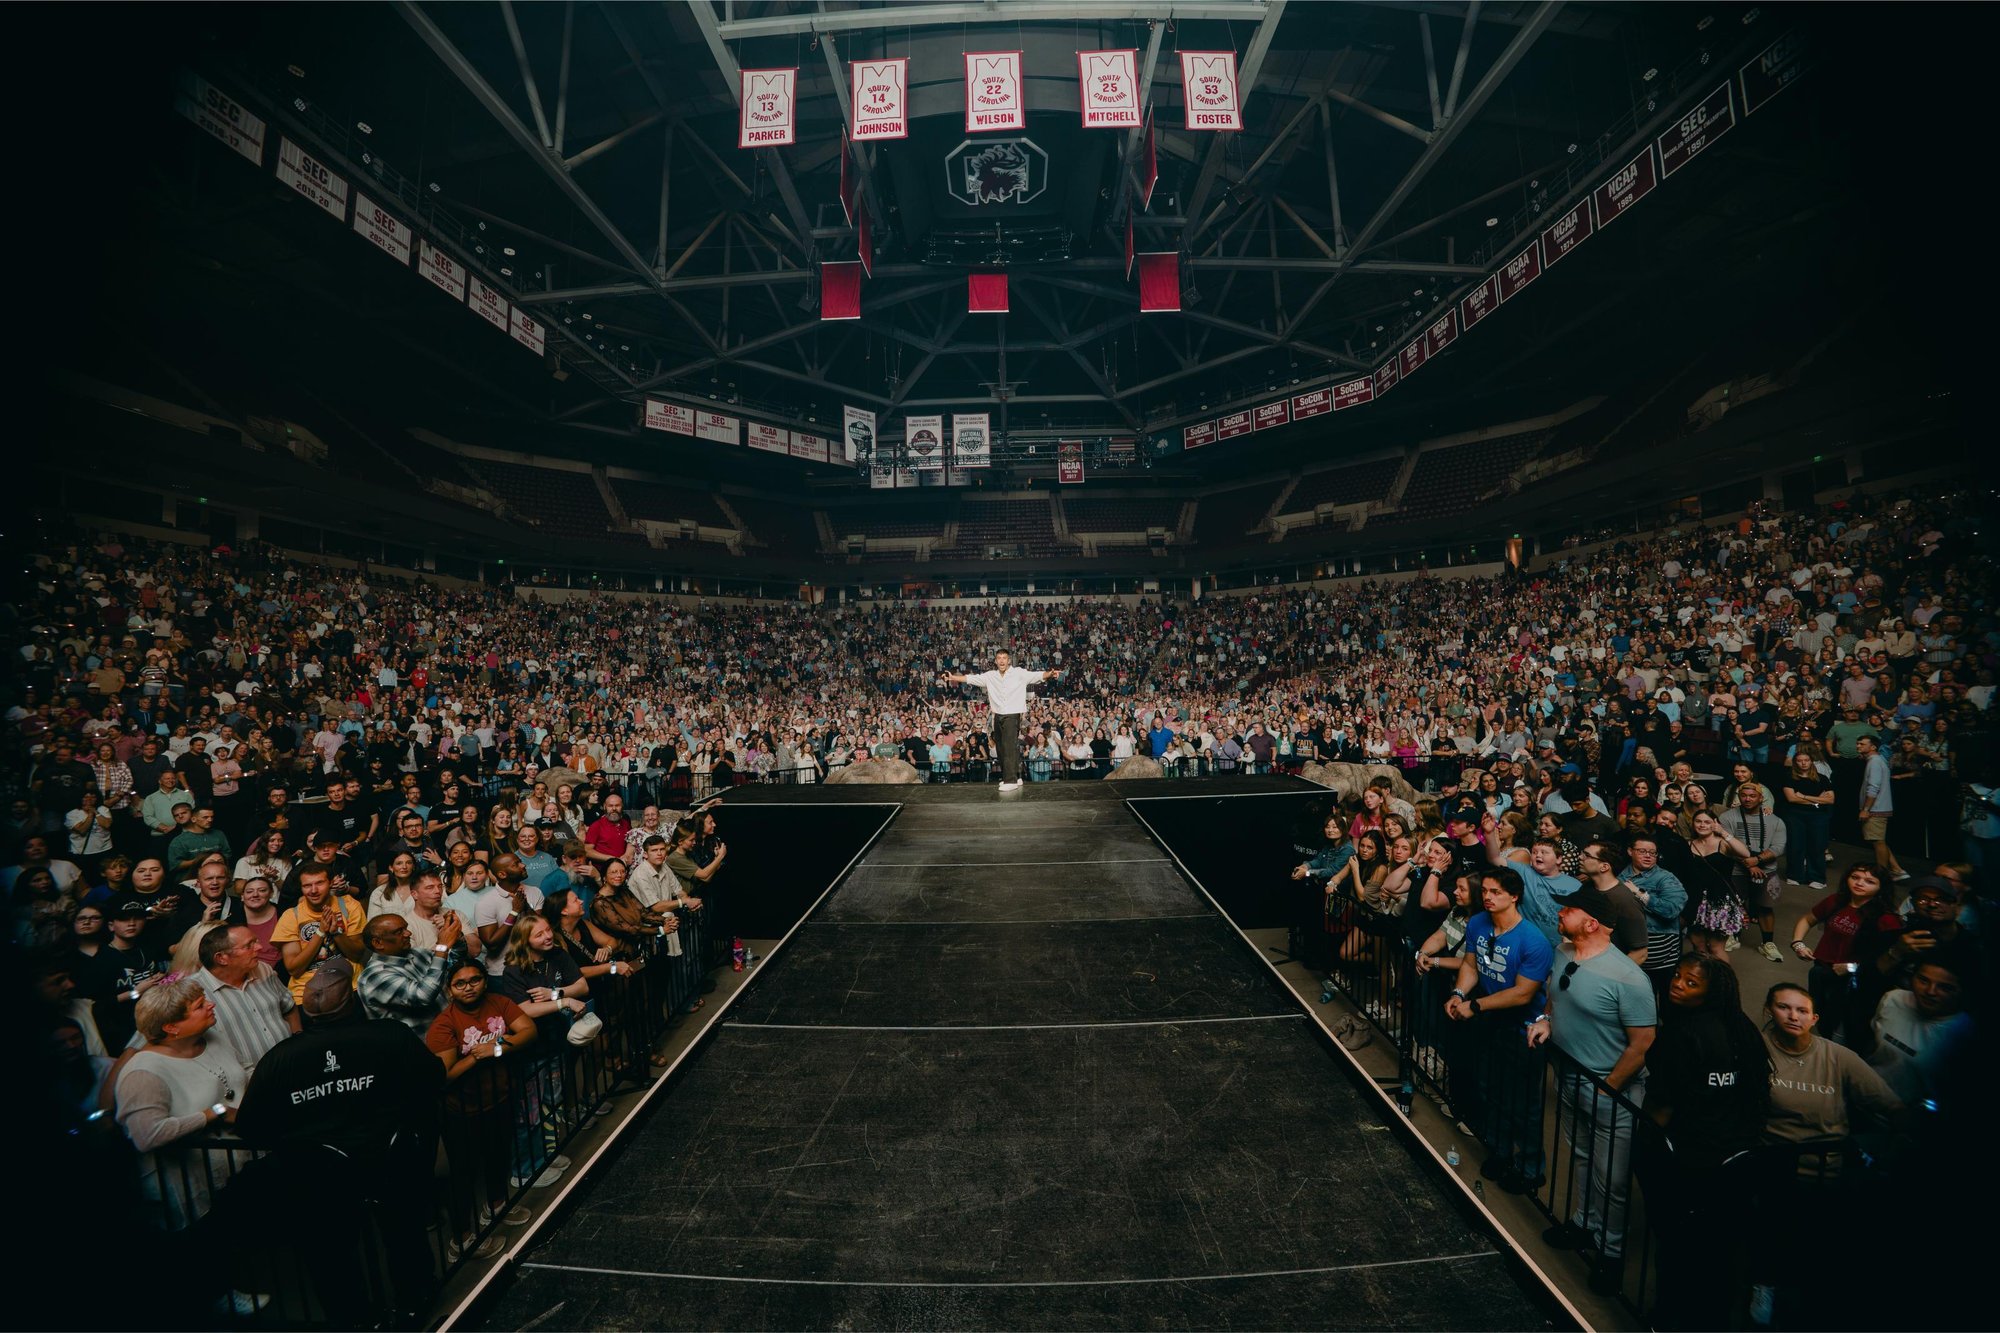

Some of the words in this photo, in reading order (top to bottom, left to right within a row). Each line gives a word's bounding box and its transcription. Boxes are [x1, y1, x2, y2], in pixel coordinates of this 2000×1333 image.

[982, 77, 1005, 85] SOUTH
[1097, 75, 1121, 84] SOUTH
[1199, 76, 1223, 85] SOUTH
[867, 85, 891, 94] SOUTH
[986, 84, 1002, 95] 22
[1102, 82, 1118, 93] 25
[1204, 85, 1219, 95] 53
[757, 93, 780, 102] SOUTH
[872, 94, 886, 104] 14
[977, 93, 1011, 105] CAROLINA
[1093, 91, 1128, 103] CAROLINA
[1195, 93, 1229, 106] CAROLINA
[207, 88, 240, 122] SEC
[762, 102, 774, 112] 13
[861, 103, 896, 115] CAROLINA
[751, 110, 784, 122] CAROLINA
[975, 113, 1015, 126] WILSON
[1088, 110, 1137, 122] MITCHELL
[1196, 114, 1233, 125] FOSTER
[1680, 106, 1707, 138] SEC
[748, 129, 786, 142] PARKER
[856, 122, 902, 136] JOHNSON
[1686, 134, 1706, 156] 1997
[302, 156, 328, 185] SEC
[1607, 163, 1638, 198] NCAA
[296, 180, 329, 208] 2019-20
[1616, 193, 1634, 210] 1989
[374, 208, 396, 233] SEC
[1553, 211, 1578, 241] NCAA
[369, 231, 396, 254] 2021-22
[1560, 237, 1574, 253] 1974
[434, 252, 453, 274] SEC
[1507, 252, 1530, 279] NCAA
[482, 287, 498, 307] SEC
[1469, 285, 1489, 308] NCAA
[521, 316, 535, 333] SEC
[1432, 317, 1449, 337] NCAA
[1406, 343, 1418, 359] ACC
[1380, 364, 1391, 379] ACC
[1340, 380, 1365, 395] SoCON
[1299, 392, 1324, 406] SoCON
[663, 405, 678, 416] SEC
[1259, 403, 1282, 418] SoCON
[711, 416, 725, 425] SEC
[1223, 414, 1245, 427] SoCON
[759, 426, 778, 437] NCAA
[1190, 425, 1210, 436] SoCON
[800, 435, 817, 445] NCAA
[1061, 462, 1081, 470] NCAA
[1476, 935, 1511, 956] Raed
[1481, 965, 1497, 980] Life
[290, 1082, 335, 1105] EVENT
[336, 1075, 375, 1093] STAFF
[1818, 1085, 1836, 1095] GO
